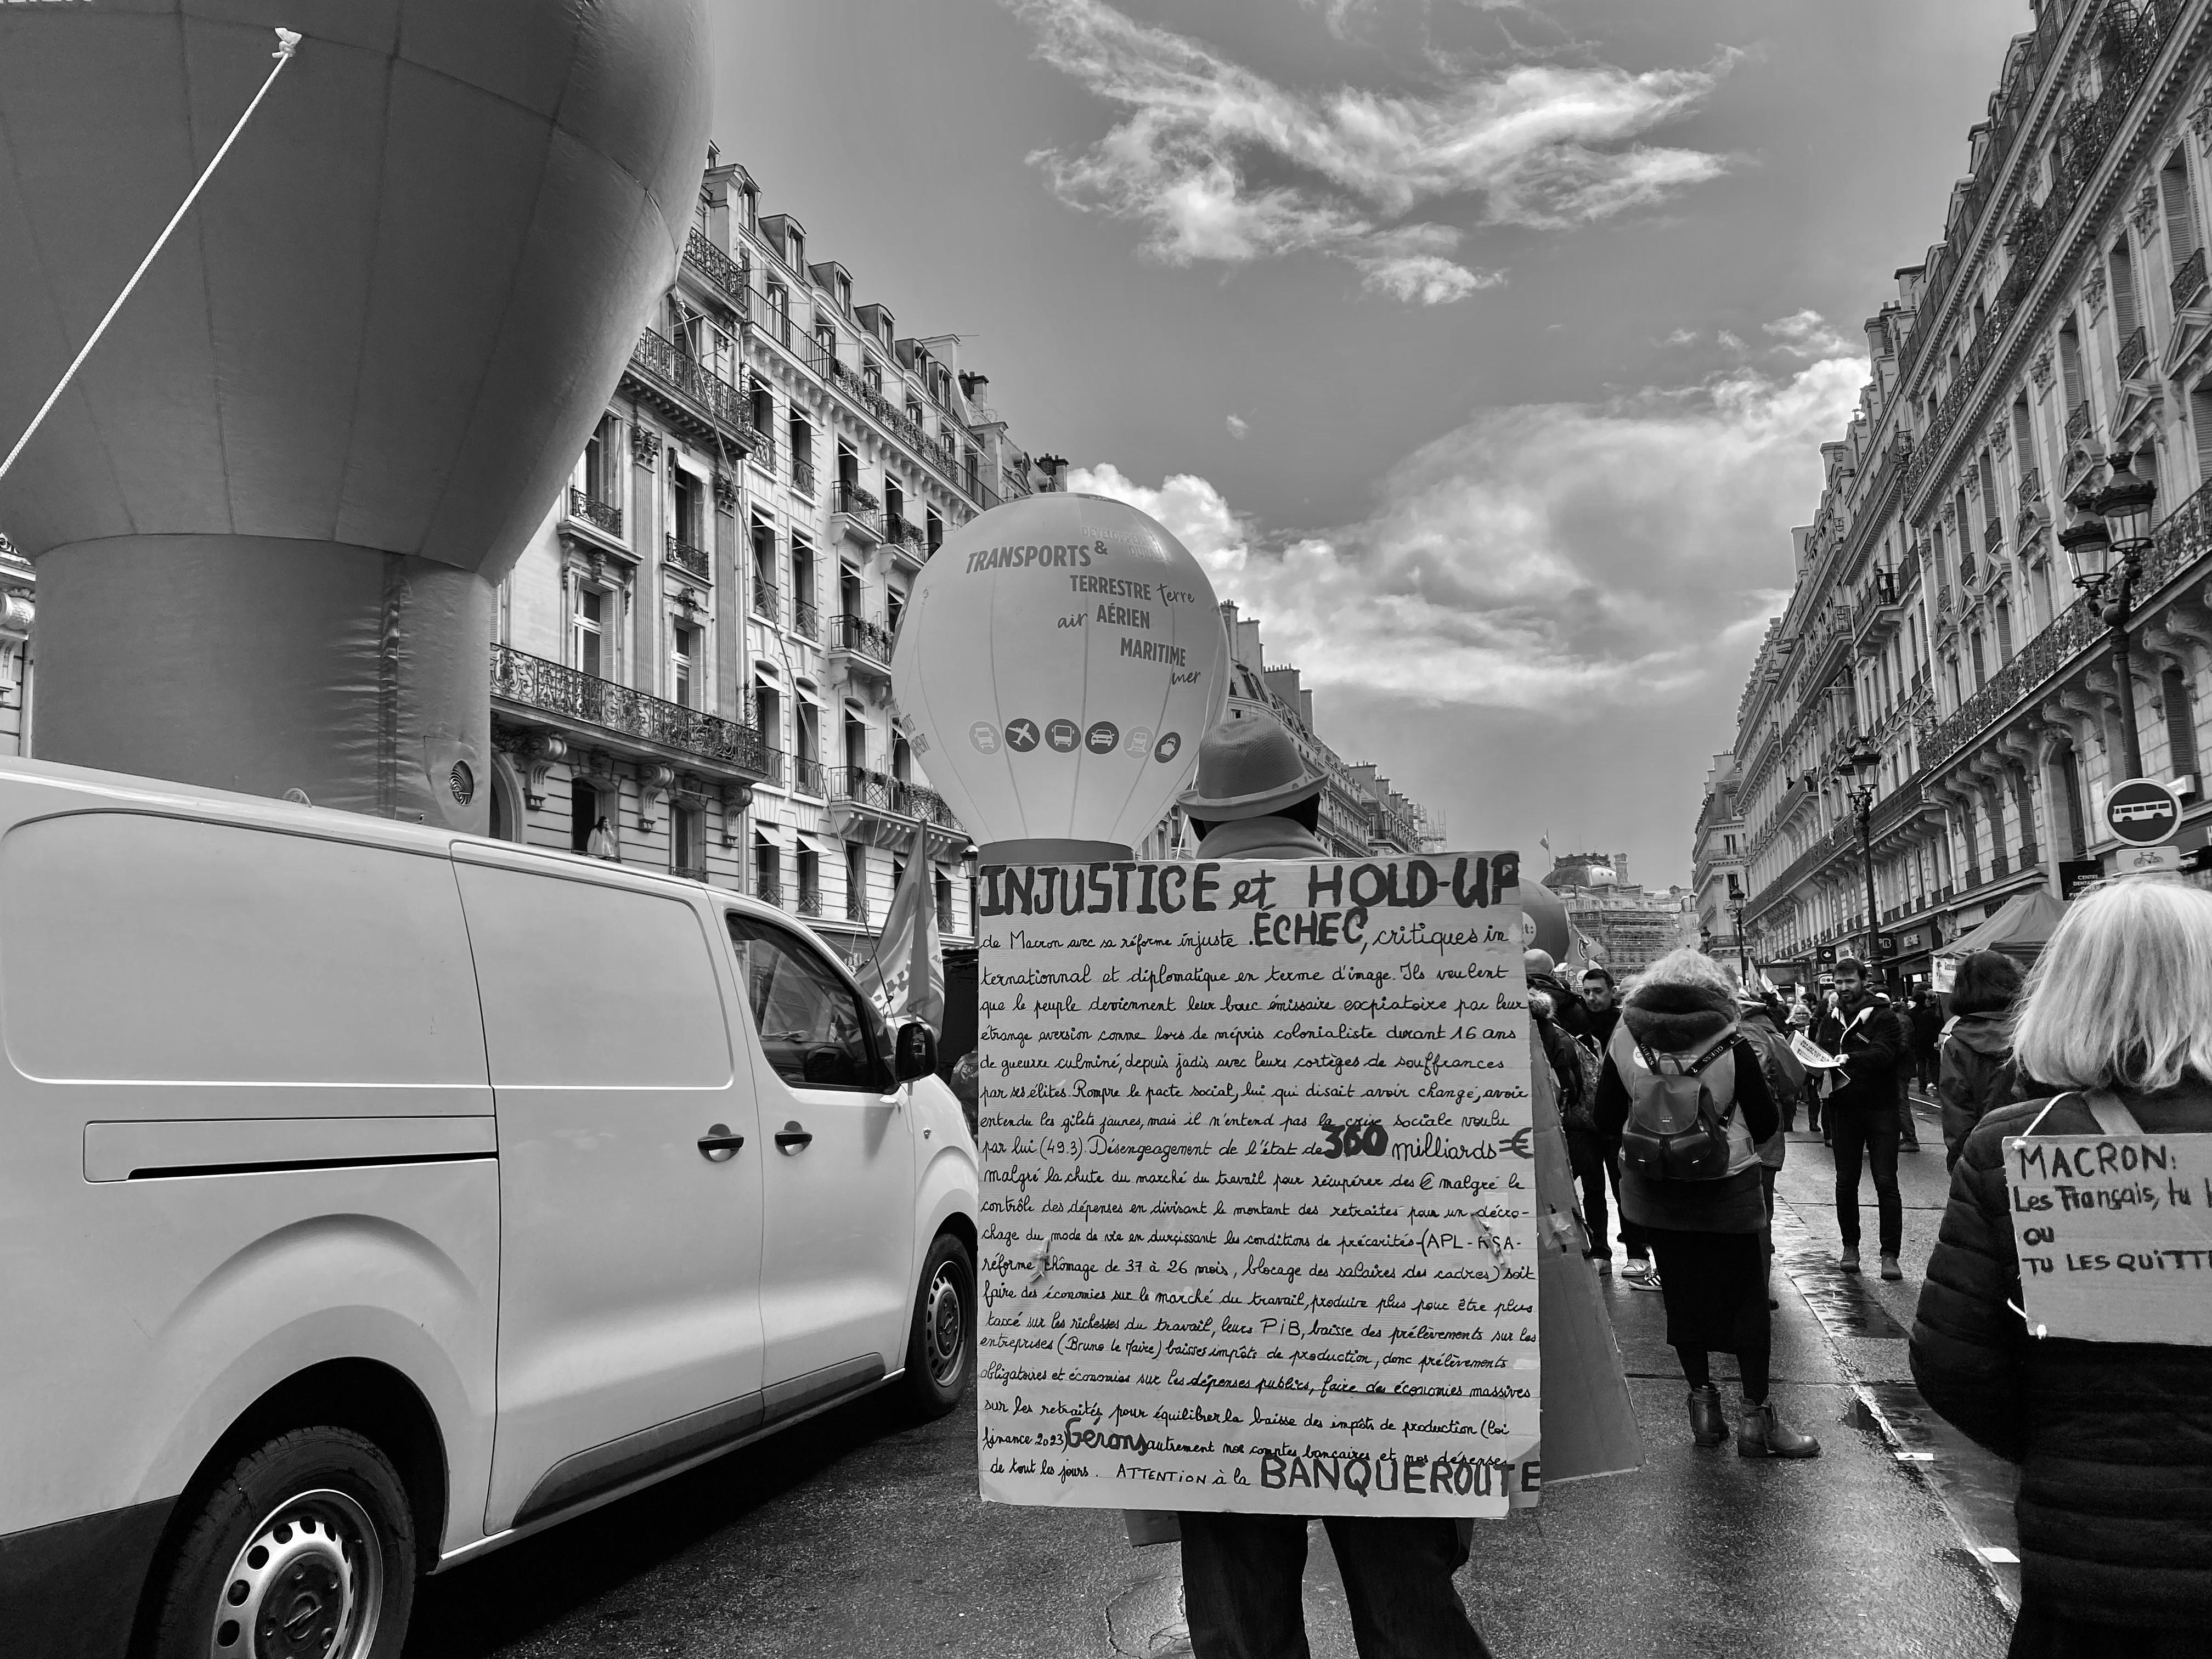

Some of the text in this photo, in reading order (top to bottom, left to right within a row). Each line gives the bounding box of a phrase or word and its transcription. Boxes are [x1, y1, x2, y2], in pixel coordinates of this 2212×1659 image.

[966, 540, 1108, 574] TRANSPORTS &
[1070, 574, 1195, 607] TERRESTRE terre
[1057, 603, 1150, 629] air AÉRIEN
[1120, 637, 1186, 667] MARITIME
[1171, 670, 1201, 685] mer
[980, 853, 1520, 916] INJUSTICE et HOLD-UP
[979, 934, 1001, 949] de
[1010, 929, 1064, 950] Macron
[1066, 939, 1096, 949] avec
[1099, 939, 1117, 949] sa
[1120, 933, 1172, 956] réforme
[1177, 928, 1238, 957] injuste
[1372, 922, 1478, 957] critiques
[980, 962, 1509, 992] ternationnal et diplomatique en terme veulent
[979, 992, 1489, 1020] que le peuple deviennent leur bouc émissaire expiatoire par
[980, 1022, 1516, 1049] étrange aversion comme lors de mépris colonialiste durant 16 ans
[980, 1050, 1504, 1079] de jadis avec leurs cortèges de souffrances
[979, 1081, 1409, 1107] par le pacte lui qui disait avoir
[980, 1109, 1510, 1133] entendu les gilets mais il pas sociale voulu
[982, 1141, 1007, 1162] par
[1011, 1136, 1037, 1155] lui
[1218, 1138, 1238, 1156] de
[1321, 1124, 1389, 1159] 360
[1044, 1166, 1063, 1183] la
[1064, 1165, 1105, 1183] chute
[1111, 1170, 1131, 1183] du
[1136, 1169, 1187, 1184] marché
[1193, 1171, 1210, 1184] du
[1215, 1170, 1266, 1186] travail
[1273, 1173, 1305, 1192] pour
[1389, 1174, 1414, 1188] des
[1041, 1199, 1319, 1216] des en divisant montant des
[2014, 1186, 2053, 1212] Les
[2168, 1177, 2192, 1206] tu
[981, 1223, 1145, 1247] chage du mode de en
[1104, 1259, 1536, 1280] de 37 26 des salaires soit
[2022, 1257, 2054, 1276] TU
[983, 1279, 1487, 1316] faire des économies marché du plus pour être
[1051, 1311, 1513, 1342] les du leurs baisse des sur
[1266, 1346, 1412, 1365] de donc
[1051, 1367, 1066, 1381] et
[1136, 1373, 1161, 1385] sur
[1167, 1369, 1184, 1386] les
[984, 1400, 1009, 1413] sur
[1012, 1395, 1033, 1415] les
[1108, 1404, 1149, 1427] pour
[1248, 1406, 1297, 1426] baisse
[1380, 1418, 1396, 1430] de
[1401, 1419, 1477, 1438] production
[990, 1457, 1005, 1474] de
[1008, 1457, 1036, 1474] tout
[1211, 1469, 1227, 1485] à
[1233, 1467, 1251, 1486] la
[1261, 1451, 1541, 1498] BANQUEROUTE
